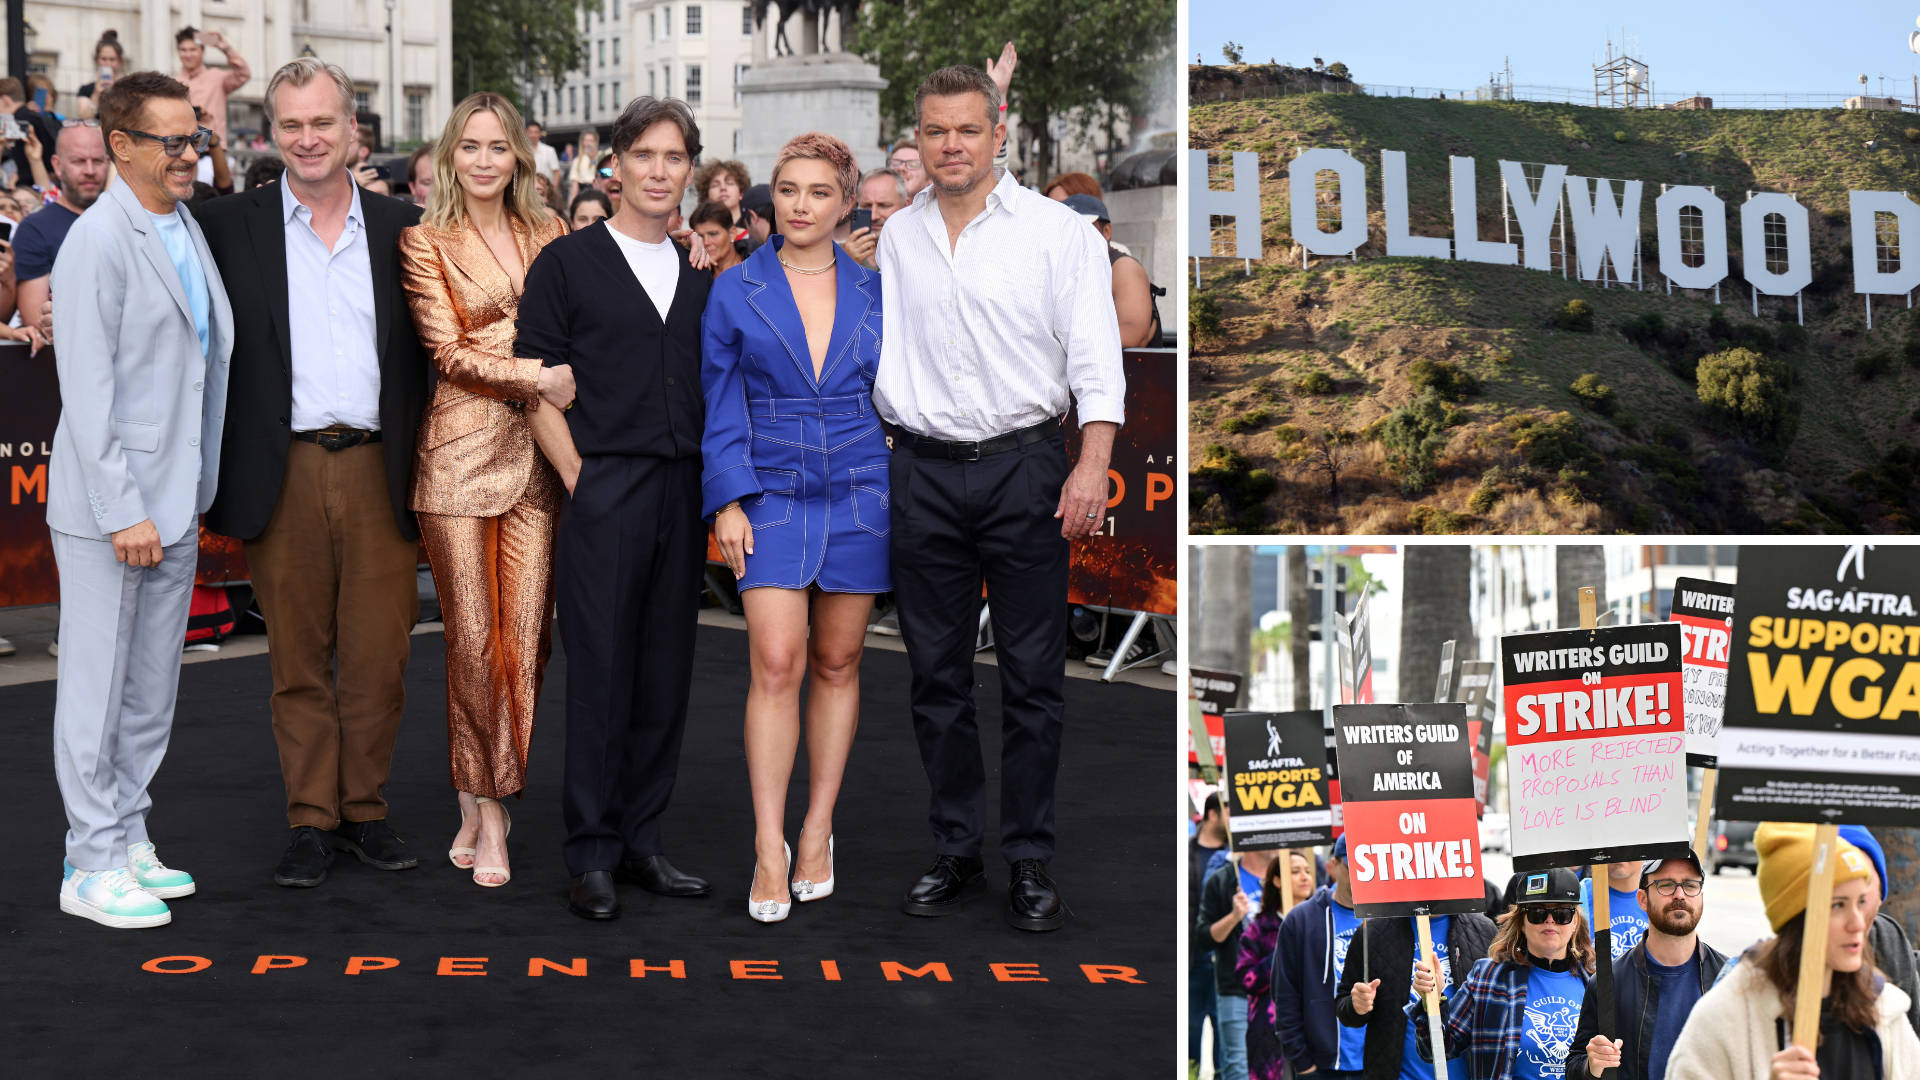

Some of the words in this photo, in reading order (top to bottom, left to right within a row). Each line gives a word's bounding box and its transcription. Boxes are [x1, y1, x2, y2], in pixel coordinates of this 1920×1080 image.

[1189, 148, 1920, 297] HOLLYWOOD
[1513, 646, 1606, 673] WRITERS
[1609, 642, 1669, 666] GUILD
[1582, 671, 1602, 685] ON
[1747, 652, 1920, 720] WGA
[1516, 682, 1671, 736] STRIKE!
[1343, 724, 1413, 744] WRITERS
[1415, 724, 1460, 743] GUILD
[1396, 749, 1413, 765] OF
[1521, 746, 1577, 776] MORE
[1591, 736, 1683, 763] REJECTED
[1234, 768, 1322, 786] SUPPORTS
[1373, 771, 1443, 791] AMERICA
[1522, 768, 1623, 800] PROPOSALS
[1632, 760, 1674, 785] THAN
[1236, 782, 1323, 811] WGA
[1576, 801, 1600, 820] IS
[1399, 812, 1427, 835] ON
[1354, 839, 1475, 882] STRIKE!
[141, 955, 1147, 984] OPPENHEIMER
[1533, 996, 1565, 1007] GUILD
